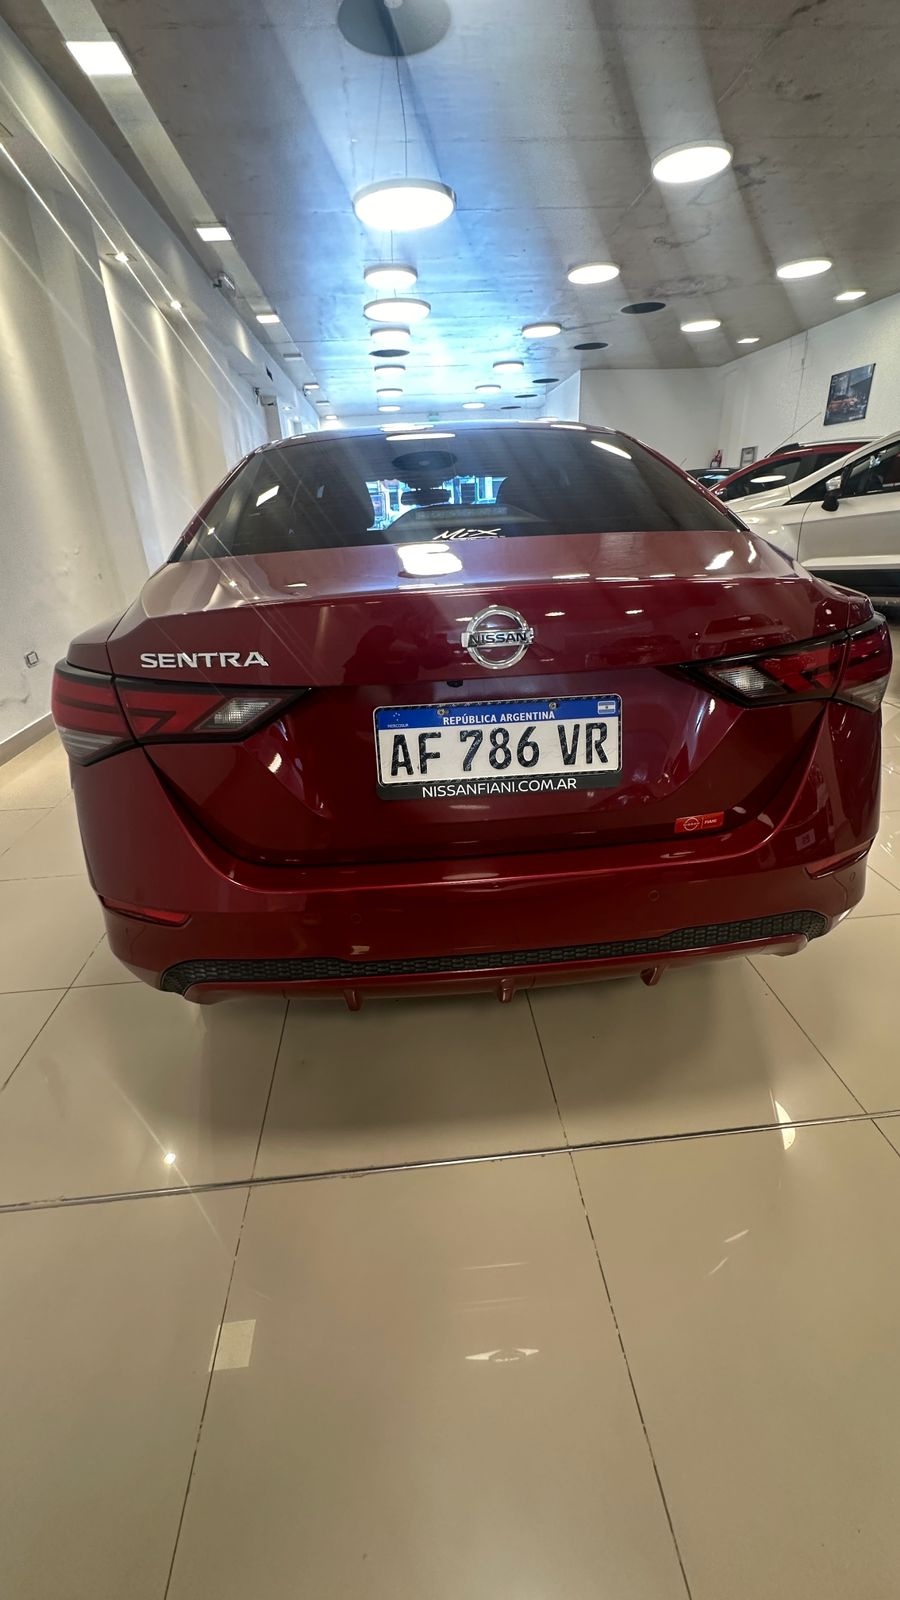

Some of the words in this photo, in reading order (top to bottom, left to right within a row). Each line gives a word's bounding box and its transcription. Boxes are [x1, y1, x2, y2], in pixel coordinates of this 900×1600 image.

[468, 632, 527, 646] NISSAN
[140, 651, 269, 668] SENTRA
[443, 713, 497, 726] REPÚBLICA
[500, 711, 555, 723] ARGENTINA
[390, 731, 442, 776] AF
[459, 726, 540, 772] 786
[557, 722, 609, 766] VR
[422, 778, 577, 798] NISSANFIANI.COM.AR
